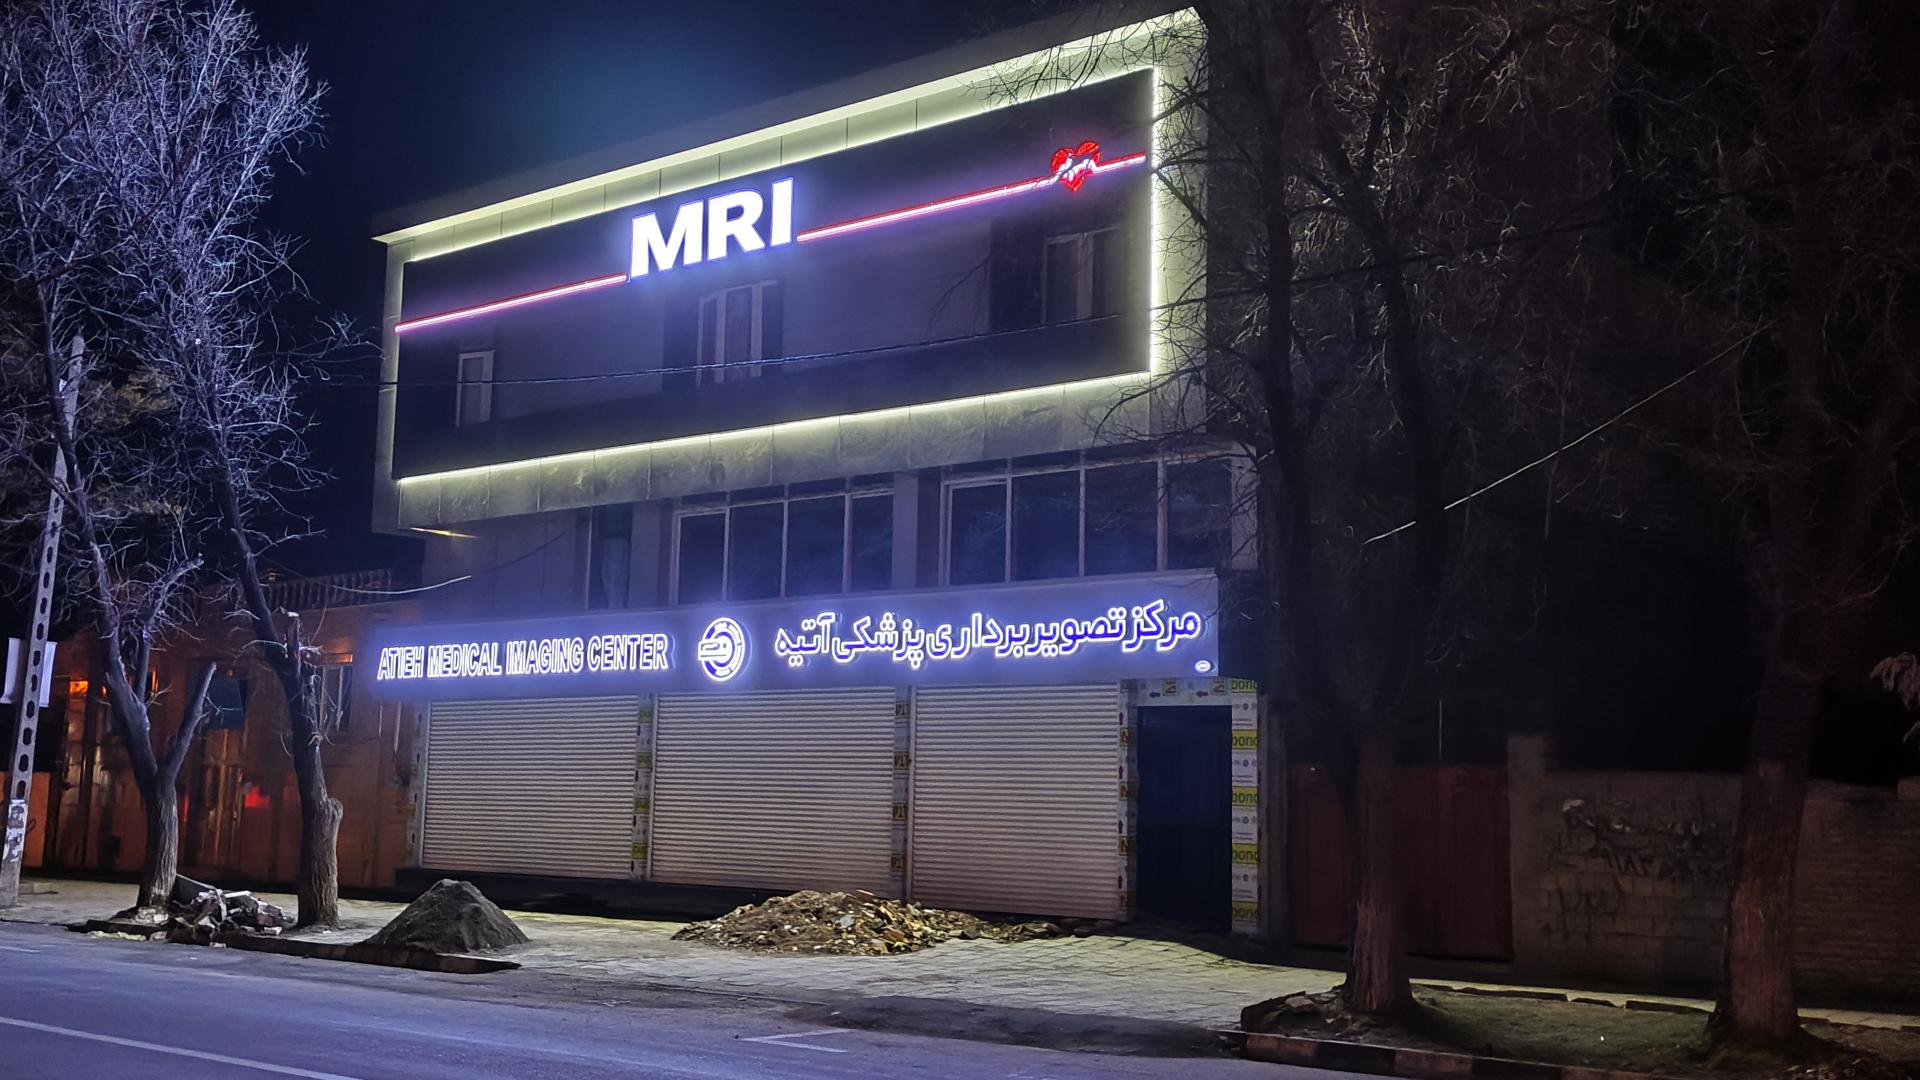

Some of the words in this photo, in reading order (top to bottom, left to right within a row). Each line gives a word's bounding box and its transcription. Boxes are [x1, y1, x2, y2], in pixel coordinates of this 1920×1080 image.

[630, 177, 794, 279] MRI
[774, 612, 836, 667] آتیه
[832, 612, 925, 669] پزشکی
[1122, 599, 1201, 653] مرکز
[377, 646, 425, 680] ATIEH
[427, 641, 503, 679] MEDICAL
[506, 637, 585, 675] IMAGING
[587, 633, 670, 671] CENTER
